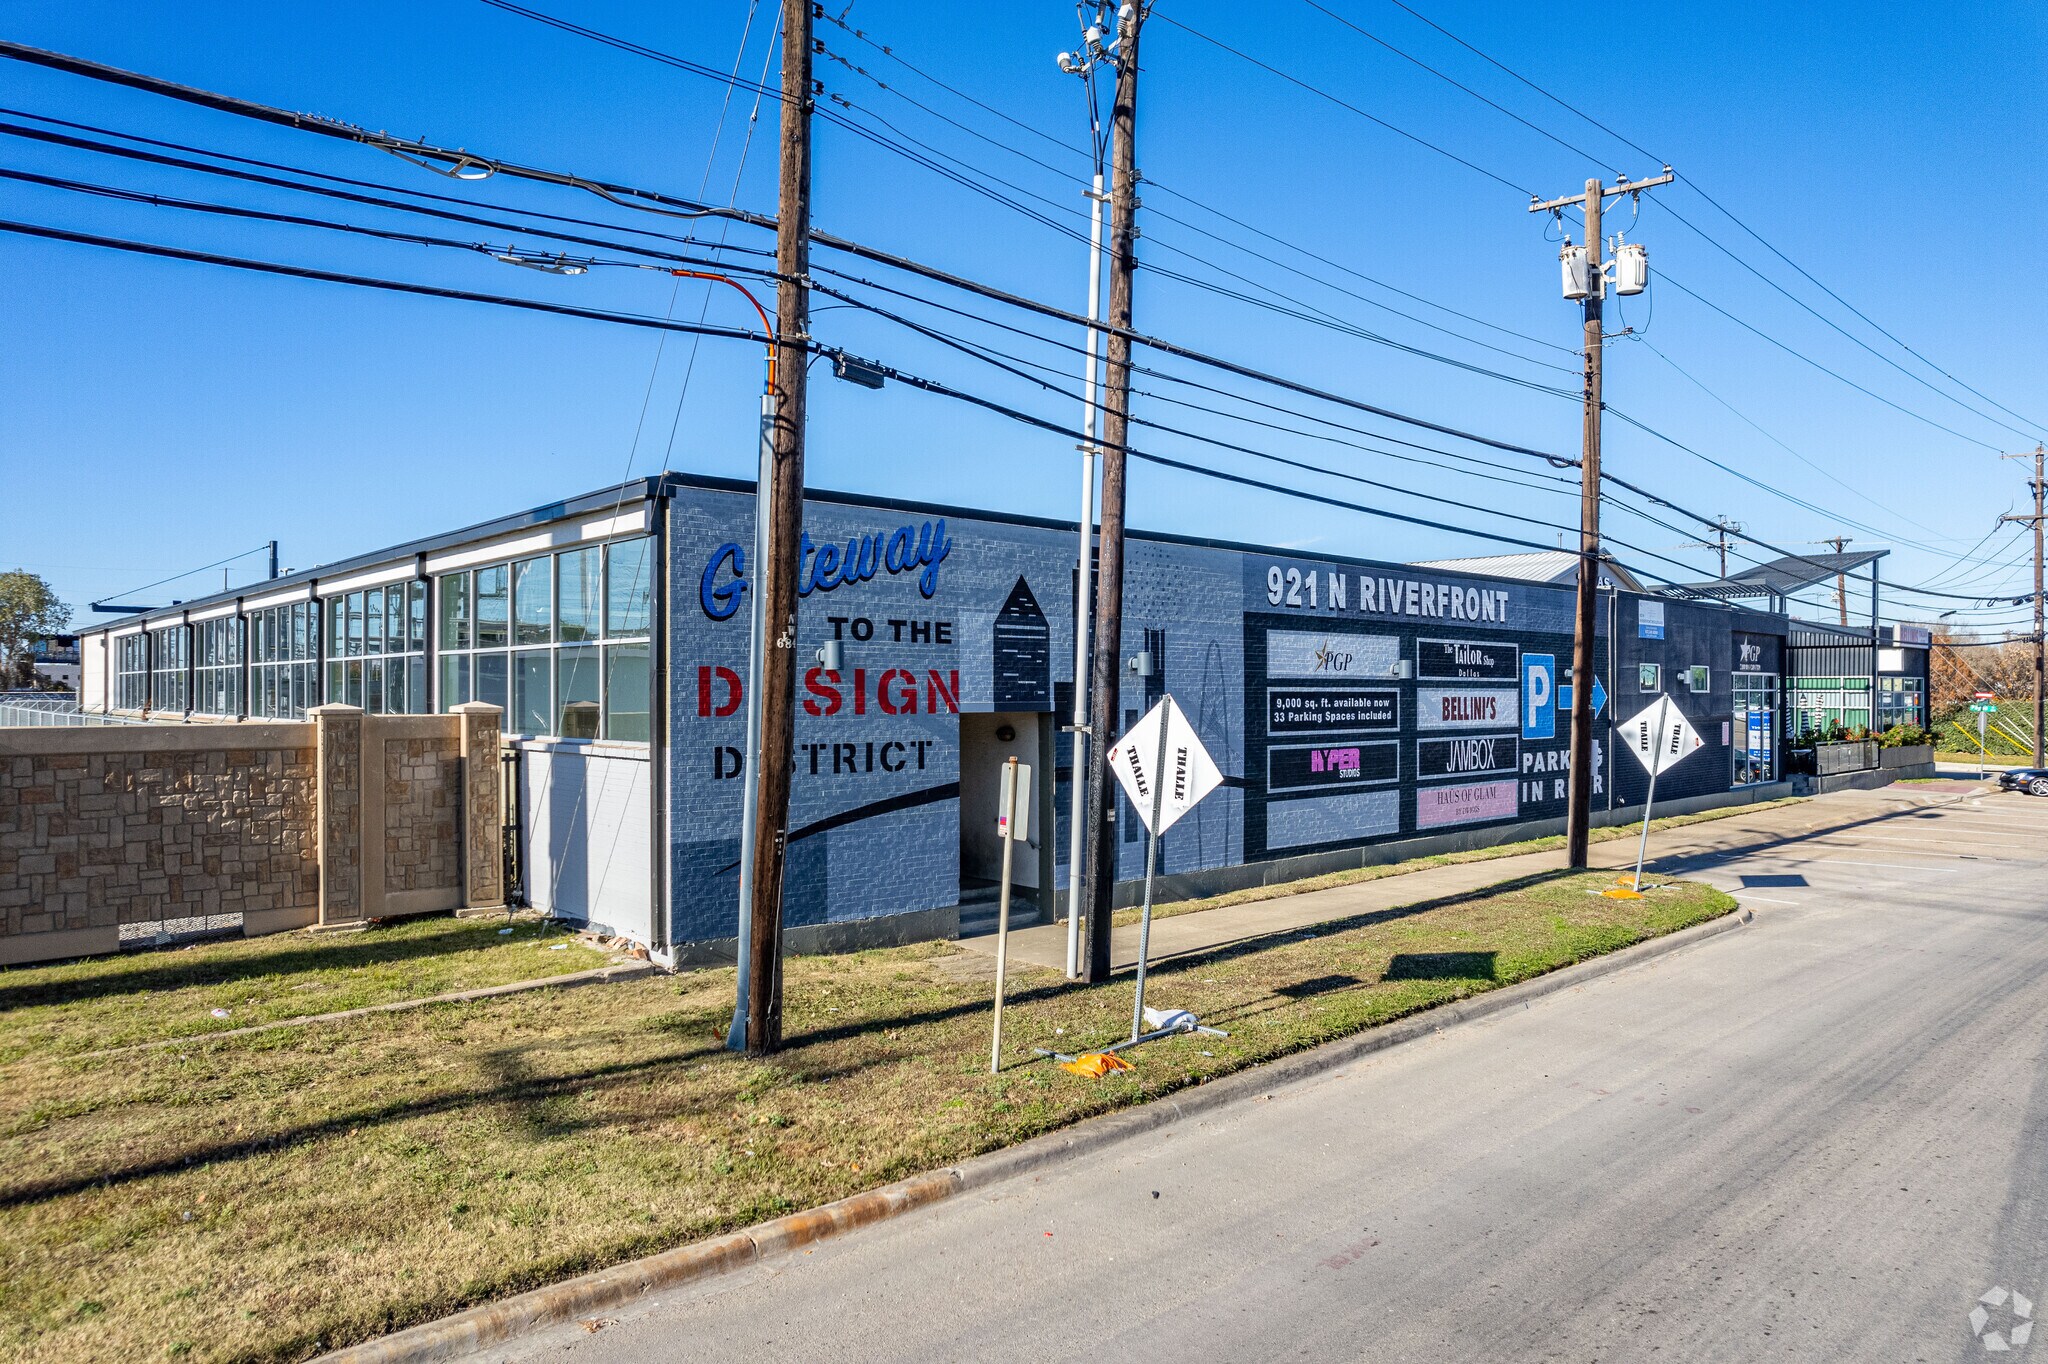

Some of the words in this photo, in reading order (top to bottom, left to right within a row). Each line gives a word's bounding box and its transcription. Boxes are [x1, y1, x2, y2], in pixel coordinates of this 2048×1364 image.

[700, 518, 951, 620] Gteway
[1267, 565, 1318, 609] 921
[1328, 572, 1347, 611] N
[1360, 574, 1509, 623] RIVERFRONT
[827, 616, 874, 641] TO
[888, 618, 952, 645] THE
[1324, 650, 1353, 672] PGP
[1443, 643, 1454, 654] The
[698, 665, 960, 717] DSIGN
[1276, 698, 1302, 710] 9,000
[1304, 700, 1319, 710] sq.
[1320, 698, 1331, 708] ft.
[1333, 698, 1372, 708] available
[1373, 699, 1390, 708] now
[1528, 665, 1551, 728] P
[1273, 712, 1286, 723] 33
[1288, 711, 1323, 723] Parking
[1325, 711, 1356, 722] Spaces
[1358, 710, 1392, 721] included
[1442, 696, 1497, 722] BELLINI'S
[1640, 721, 1649, 752] THALLE
[1670, 724, 1682, 755] THALLE
[714, 740, 933, 781] DTRICT
[1311, 748, 1360, 772] HYPER
[1446, 739, 1496, 772] JAMBOX
[1126, 745, 1149, 797] THALLE
[1174, 746, 1188, 801] THALLE
[1339, 768, 1361, 778] STUDIOS
[1461, 788, 1473, 803] OF
[1473, 786, 1497, 801] GLAM
[1522, 780, 1543, 803] IN
